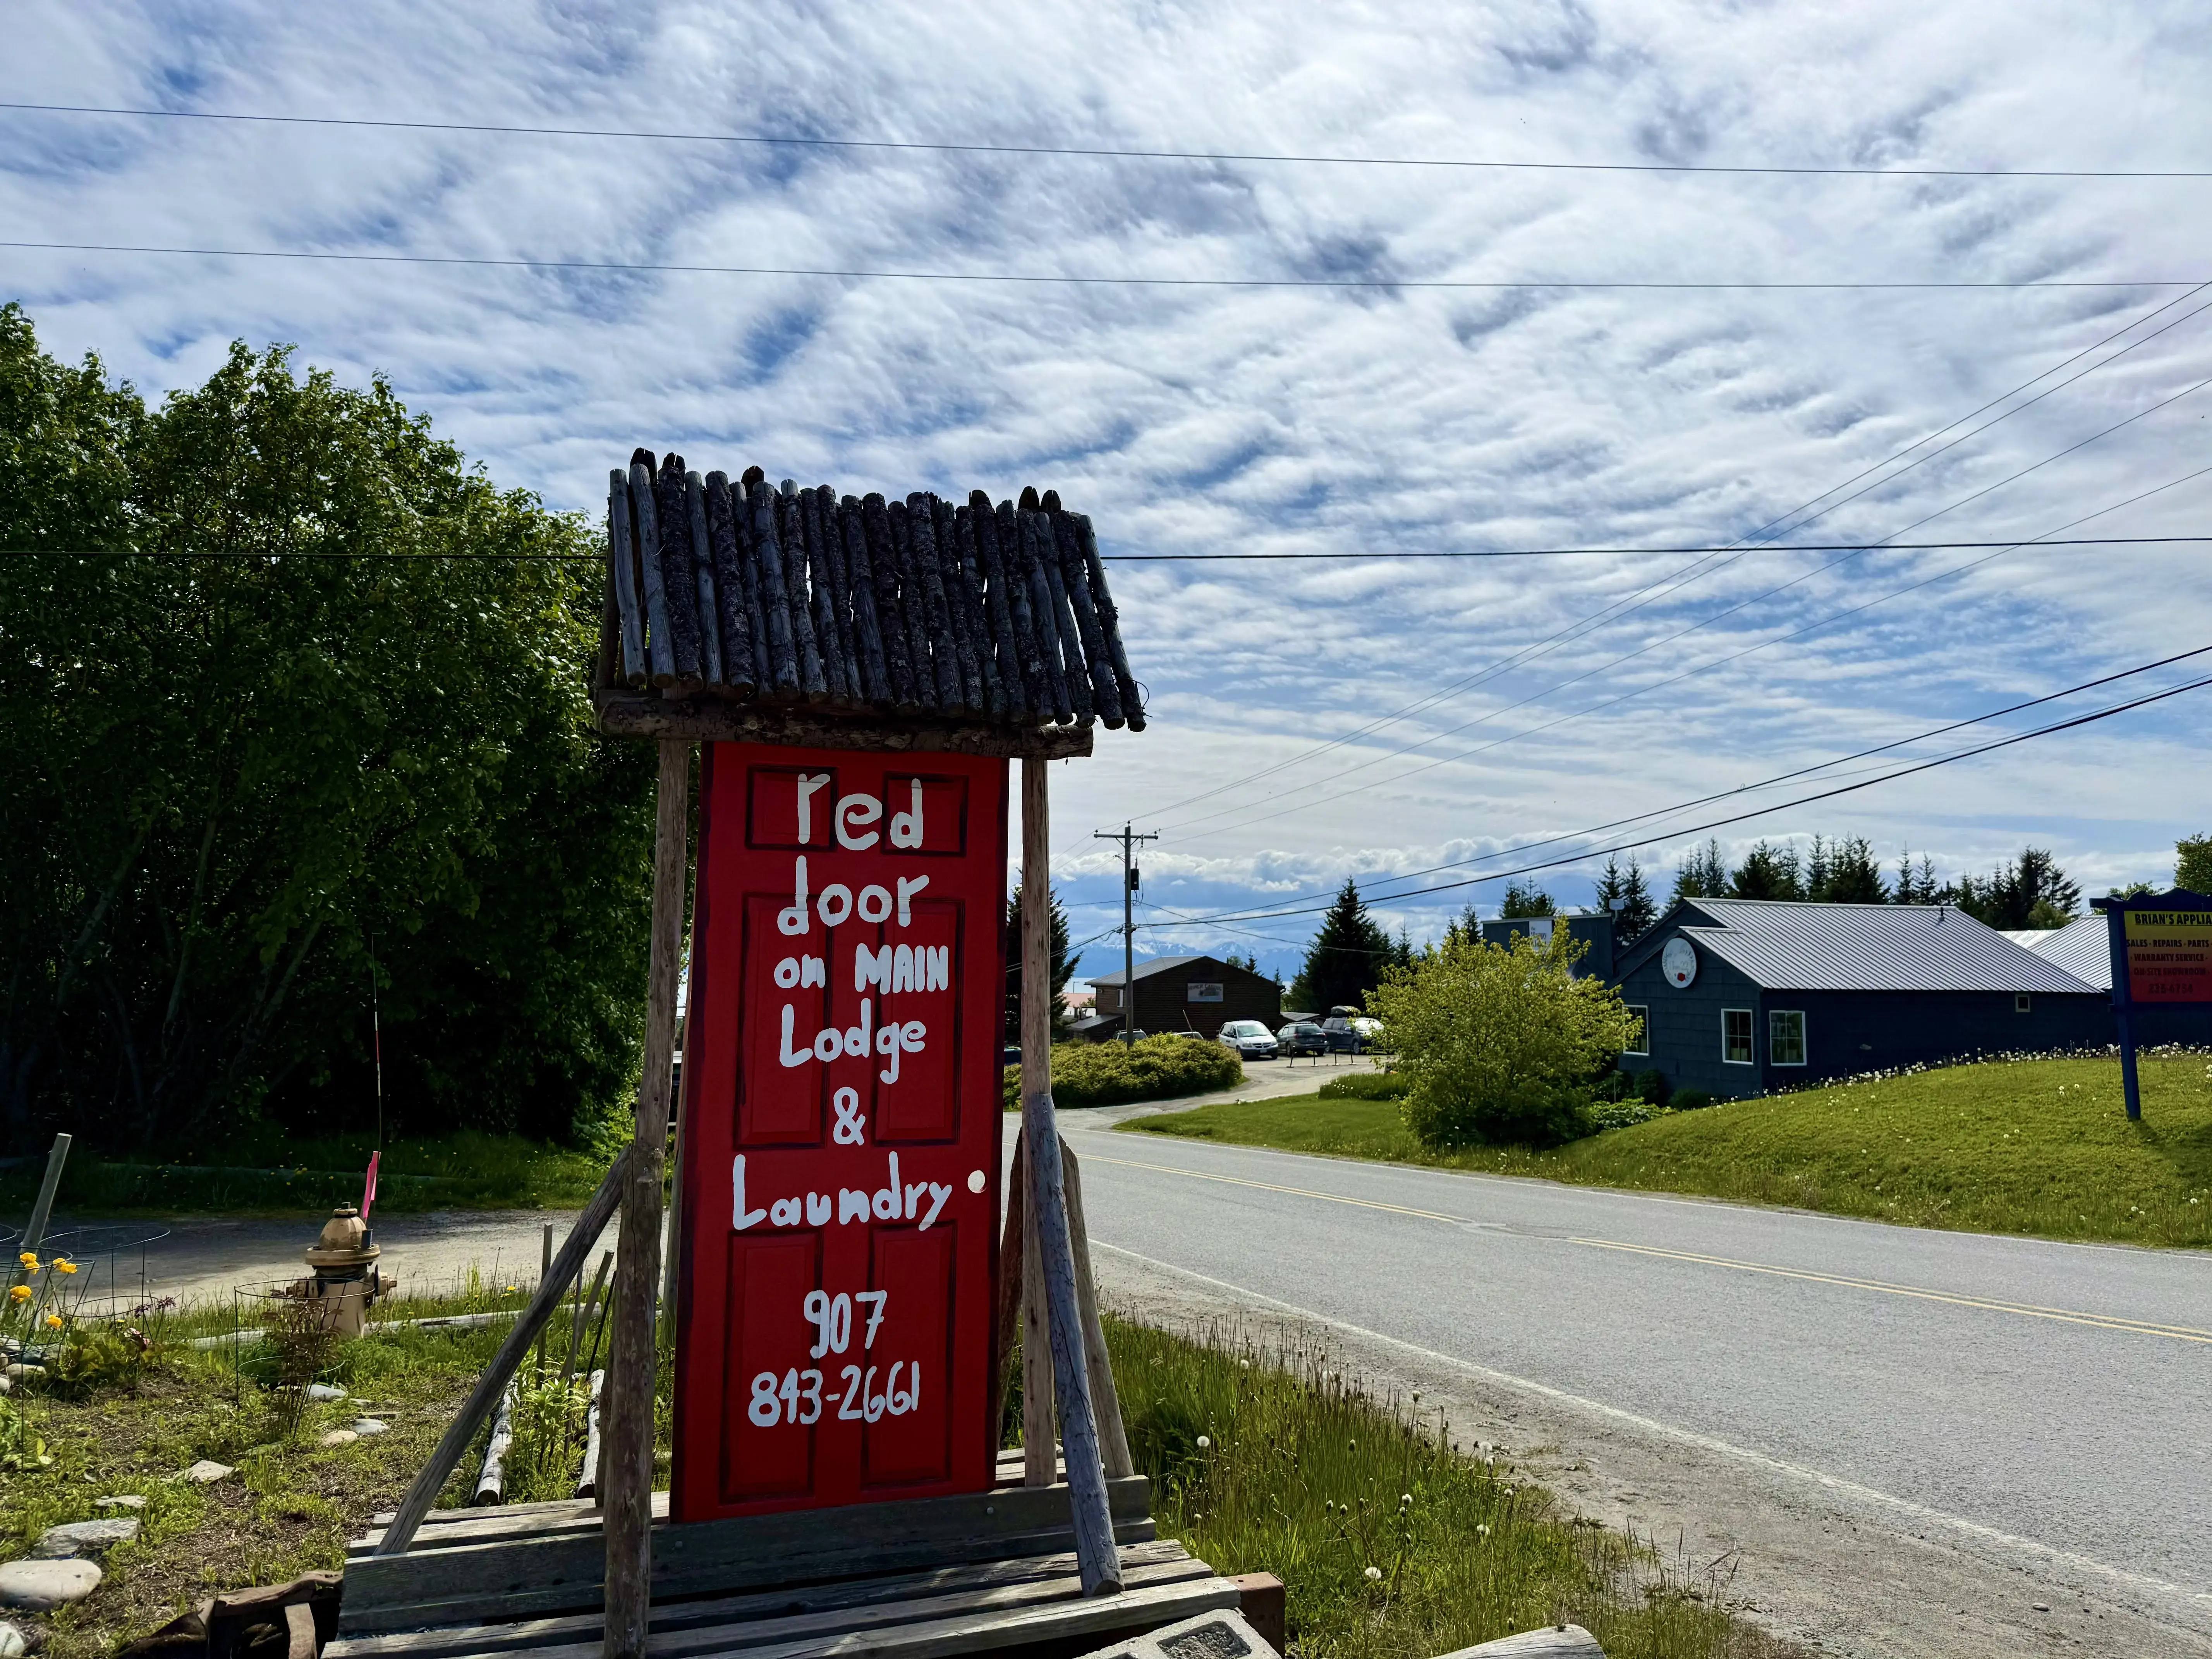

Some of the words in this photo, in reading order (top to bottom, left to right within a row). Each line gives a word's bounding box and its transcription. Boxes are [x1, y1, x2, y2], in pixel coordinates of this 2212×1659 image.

[798, 774, 923, 850] red
[778, 855, 929, 935] door
[2135, 914, 2174, 924] BRIAN'S
[2176, 914, 2212, 925] APPLIA
[774, 954, 826, 988] on
[855, 943, 948, 994] MAIN
[779, 998, 926, 1084] Lodge
[833, 1087, 866, 1146] &
[733, 1151, 952, 1231] Laundry
[804, 1290, 887, 1359] 907
[748, 1361, 919, 1427] 843-2661
